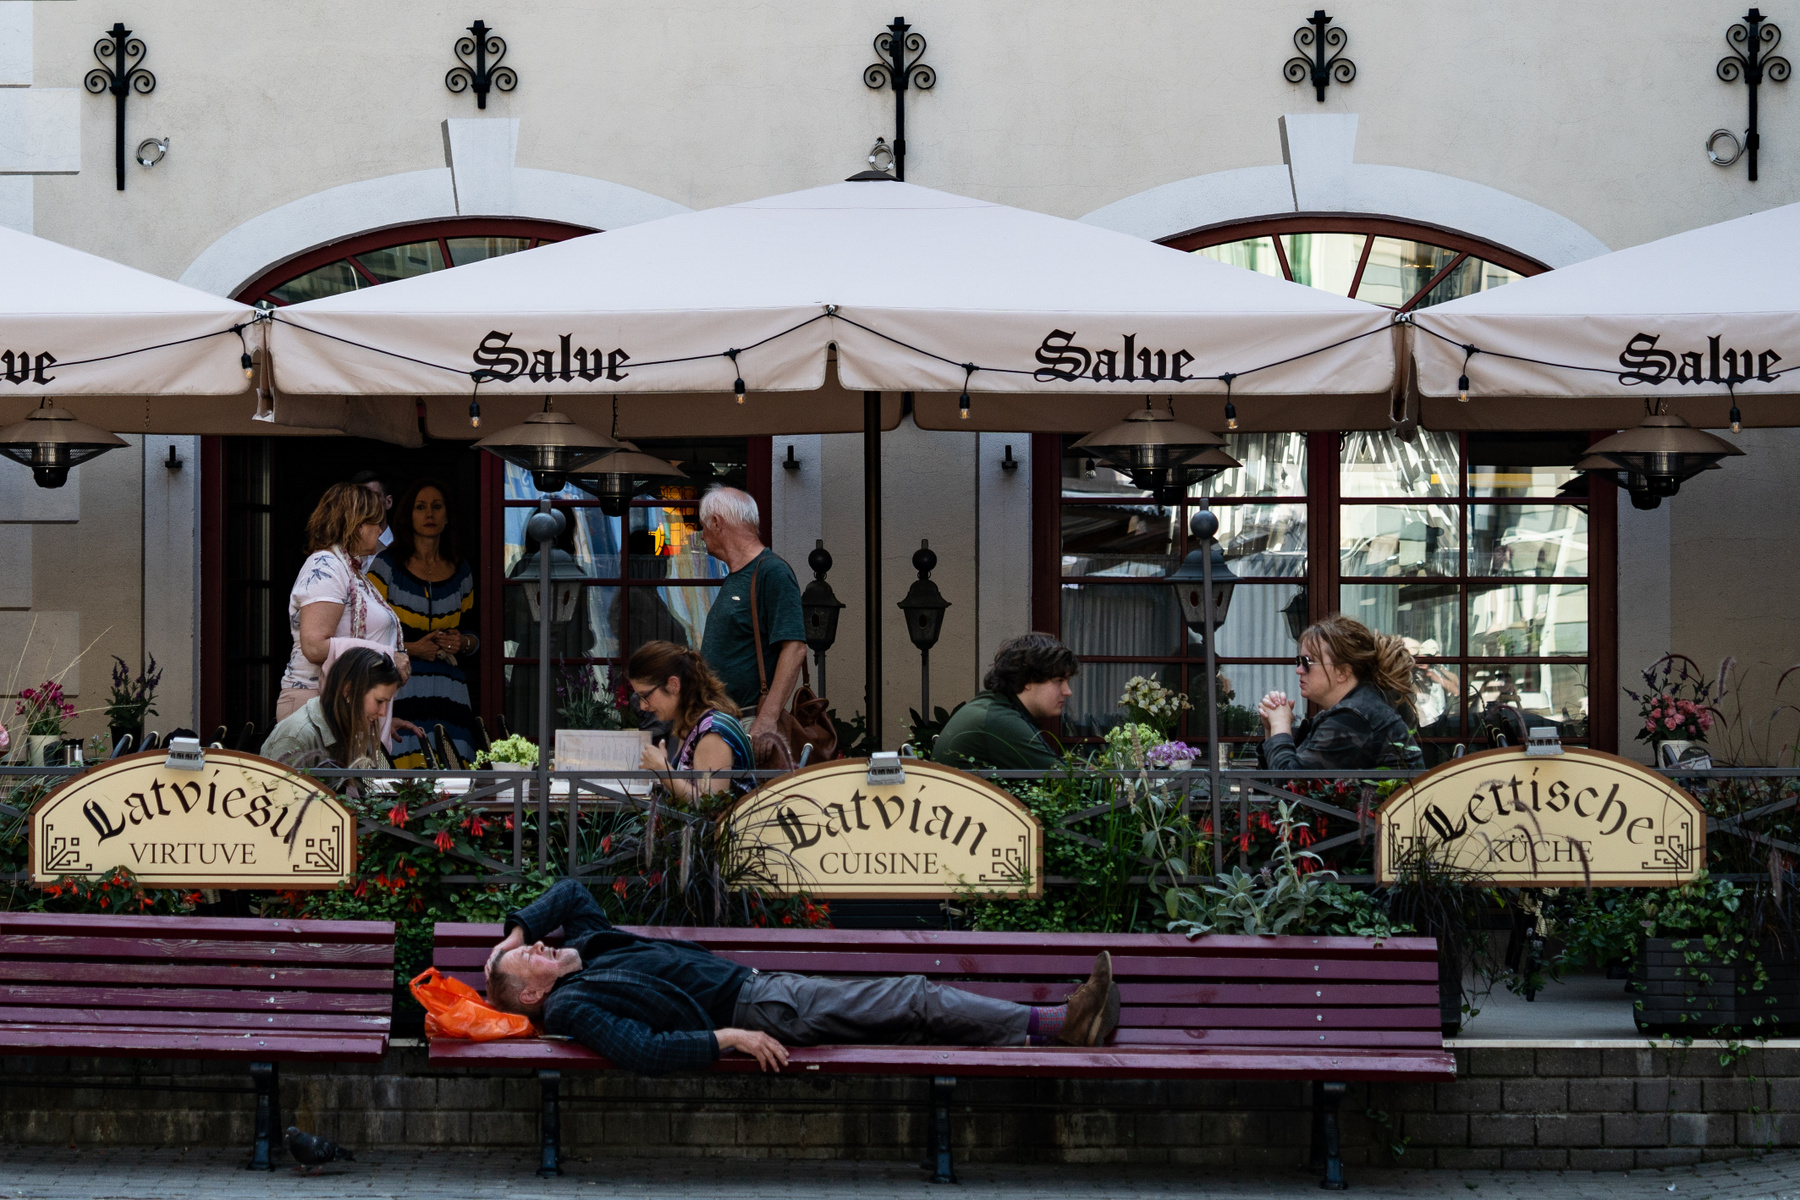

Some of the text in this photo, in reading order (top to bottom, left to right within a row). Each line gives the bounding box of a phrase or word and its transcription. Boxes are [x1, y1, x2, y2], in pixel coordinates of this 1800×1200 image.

[472, 330, 631, 383] Salve
[1034, 329, 1195, 383] Salve
[1618, 332, 1782, 385] Salve
[776, 785, 988, 856] Latvian
[1424, 766, 1654, 850] Lettische
[129, 842, 257, 865] VIRTUVE
[819, 852, 939, 875] CUISINE
[1487, 834, 1594, 863] KÜCHE
